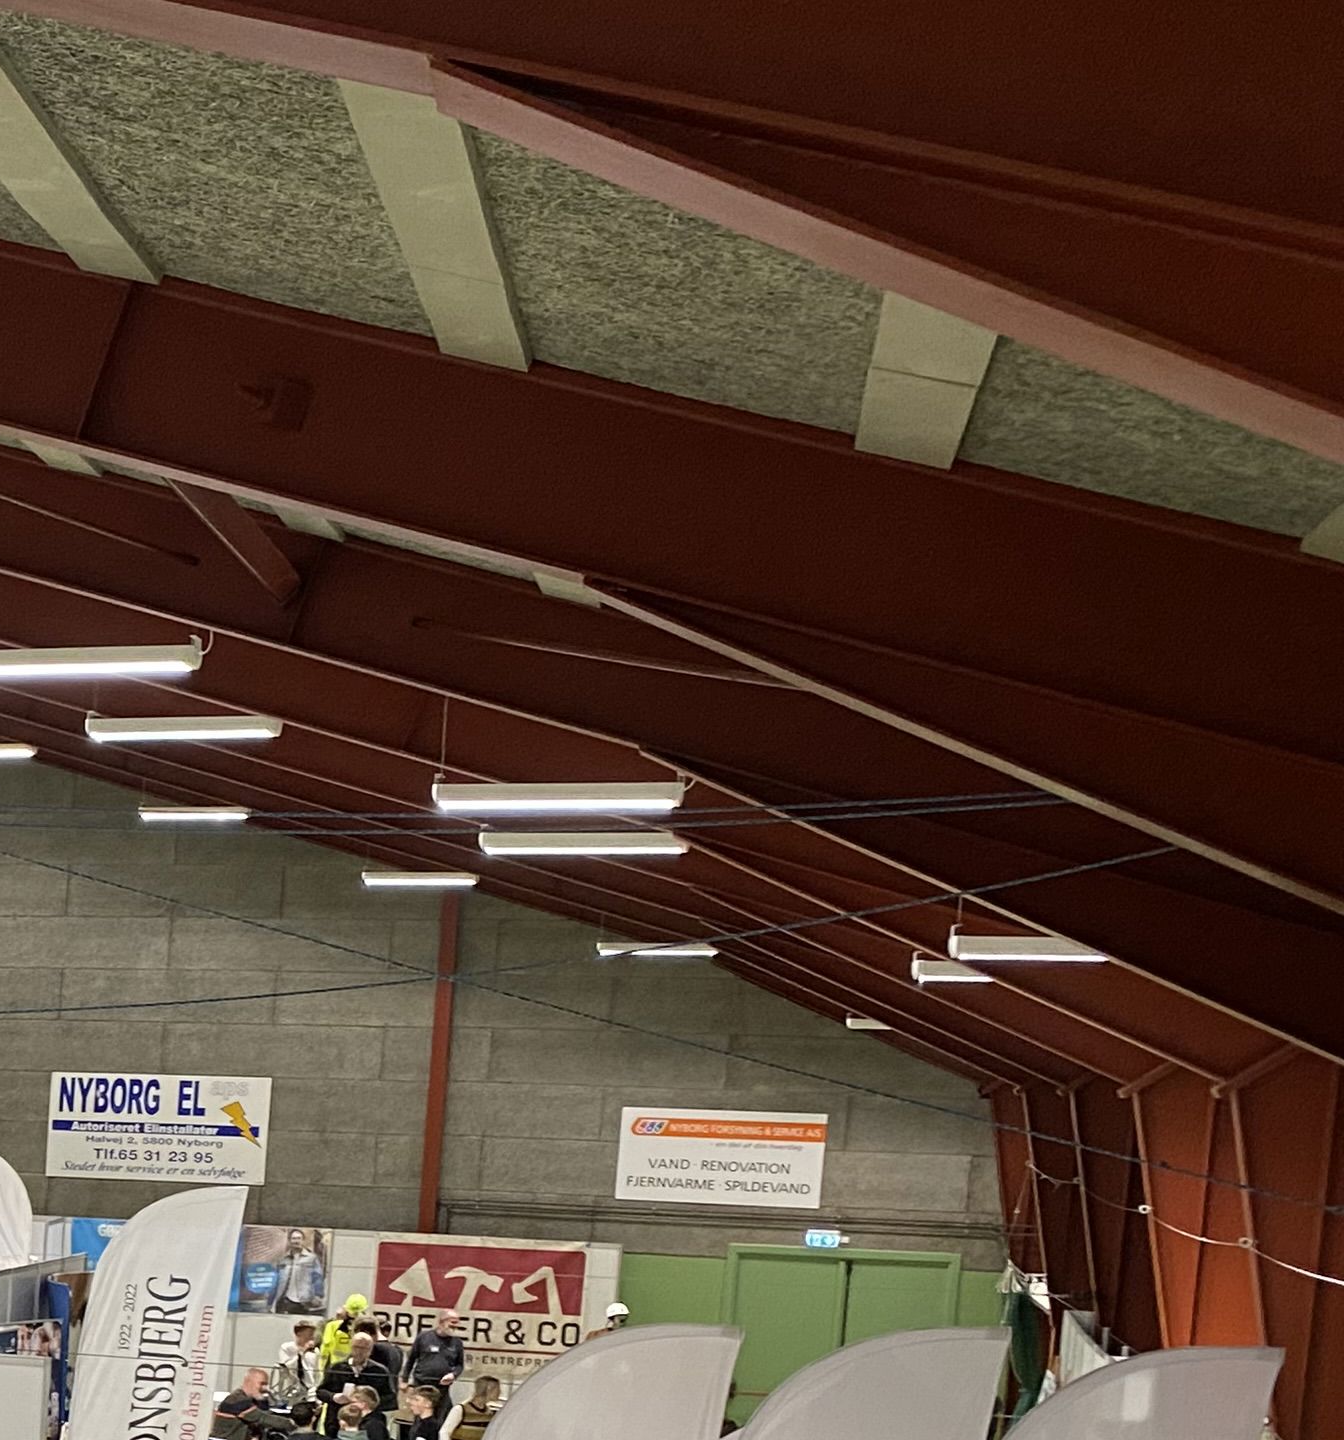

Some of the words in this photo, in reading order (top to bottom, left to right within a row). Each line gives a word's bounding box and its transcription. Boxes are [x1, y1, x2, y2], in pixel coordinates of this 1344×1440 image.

[59, 1077, 160, 1115] NYBORG
[177, 1080, 206, 1116] EL
[71, 1121, 141, 1133] Autoriseret
[669, 1122, 709, 1134] NYBORG
[142, 1137, 173, 1146] 5800
[177, 1139, 223, 1149] Nyborg
[144, 1150, 161, 1161] 31
[168, 1151, 188, 1162] 23
[193, 1152, 214, 1163] 95
[648, 1158, 691, 1170] VAND
[700, 1160, 791, 1174] RENOVATION
[126, 1165, 162, 1175] service
[166, 1167, 178, 1175] er
[626, 1175, 715, 1191] FJERNVARME
[724, 1180, 811, 1195] SPILDEVAND
[123, 1283, 138, 1313] 2022
[118, 1323, 134, 1351] 1922
[504, 1319, 525, 1345] &
[537, 1321, 580, 1347] CO
[187, 1305, 215, 1388] jubilæum
[182, 1392, 201, 1418] års
